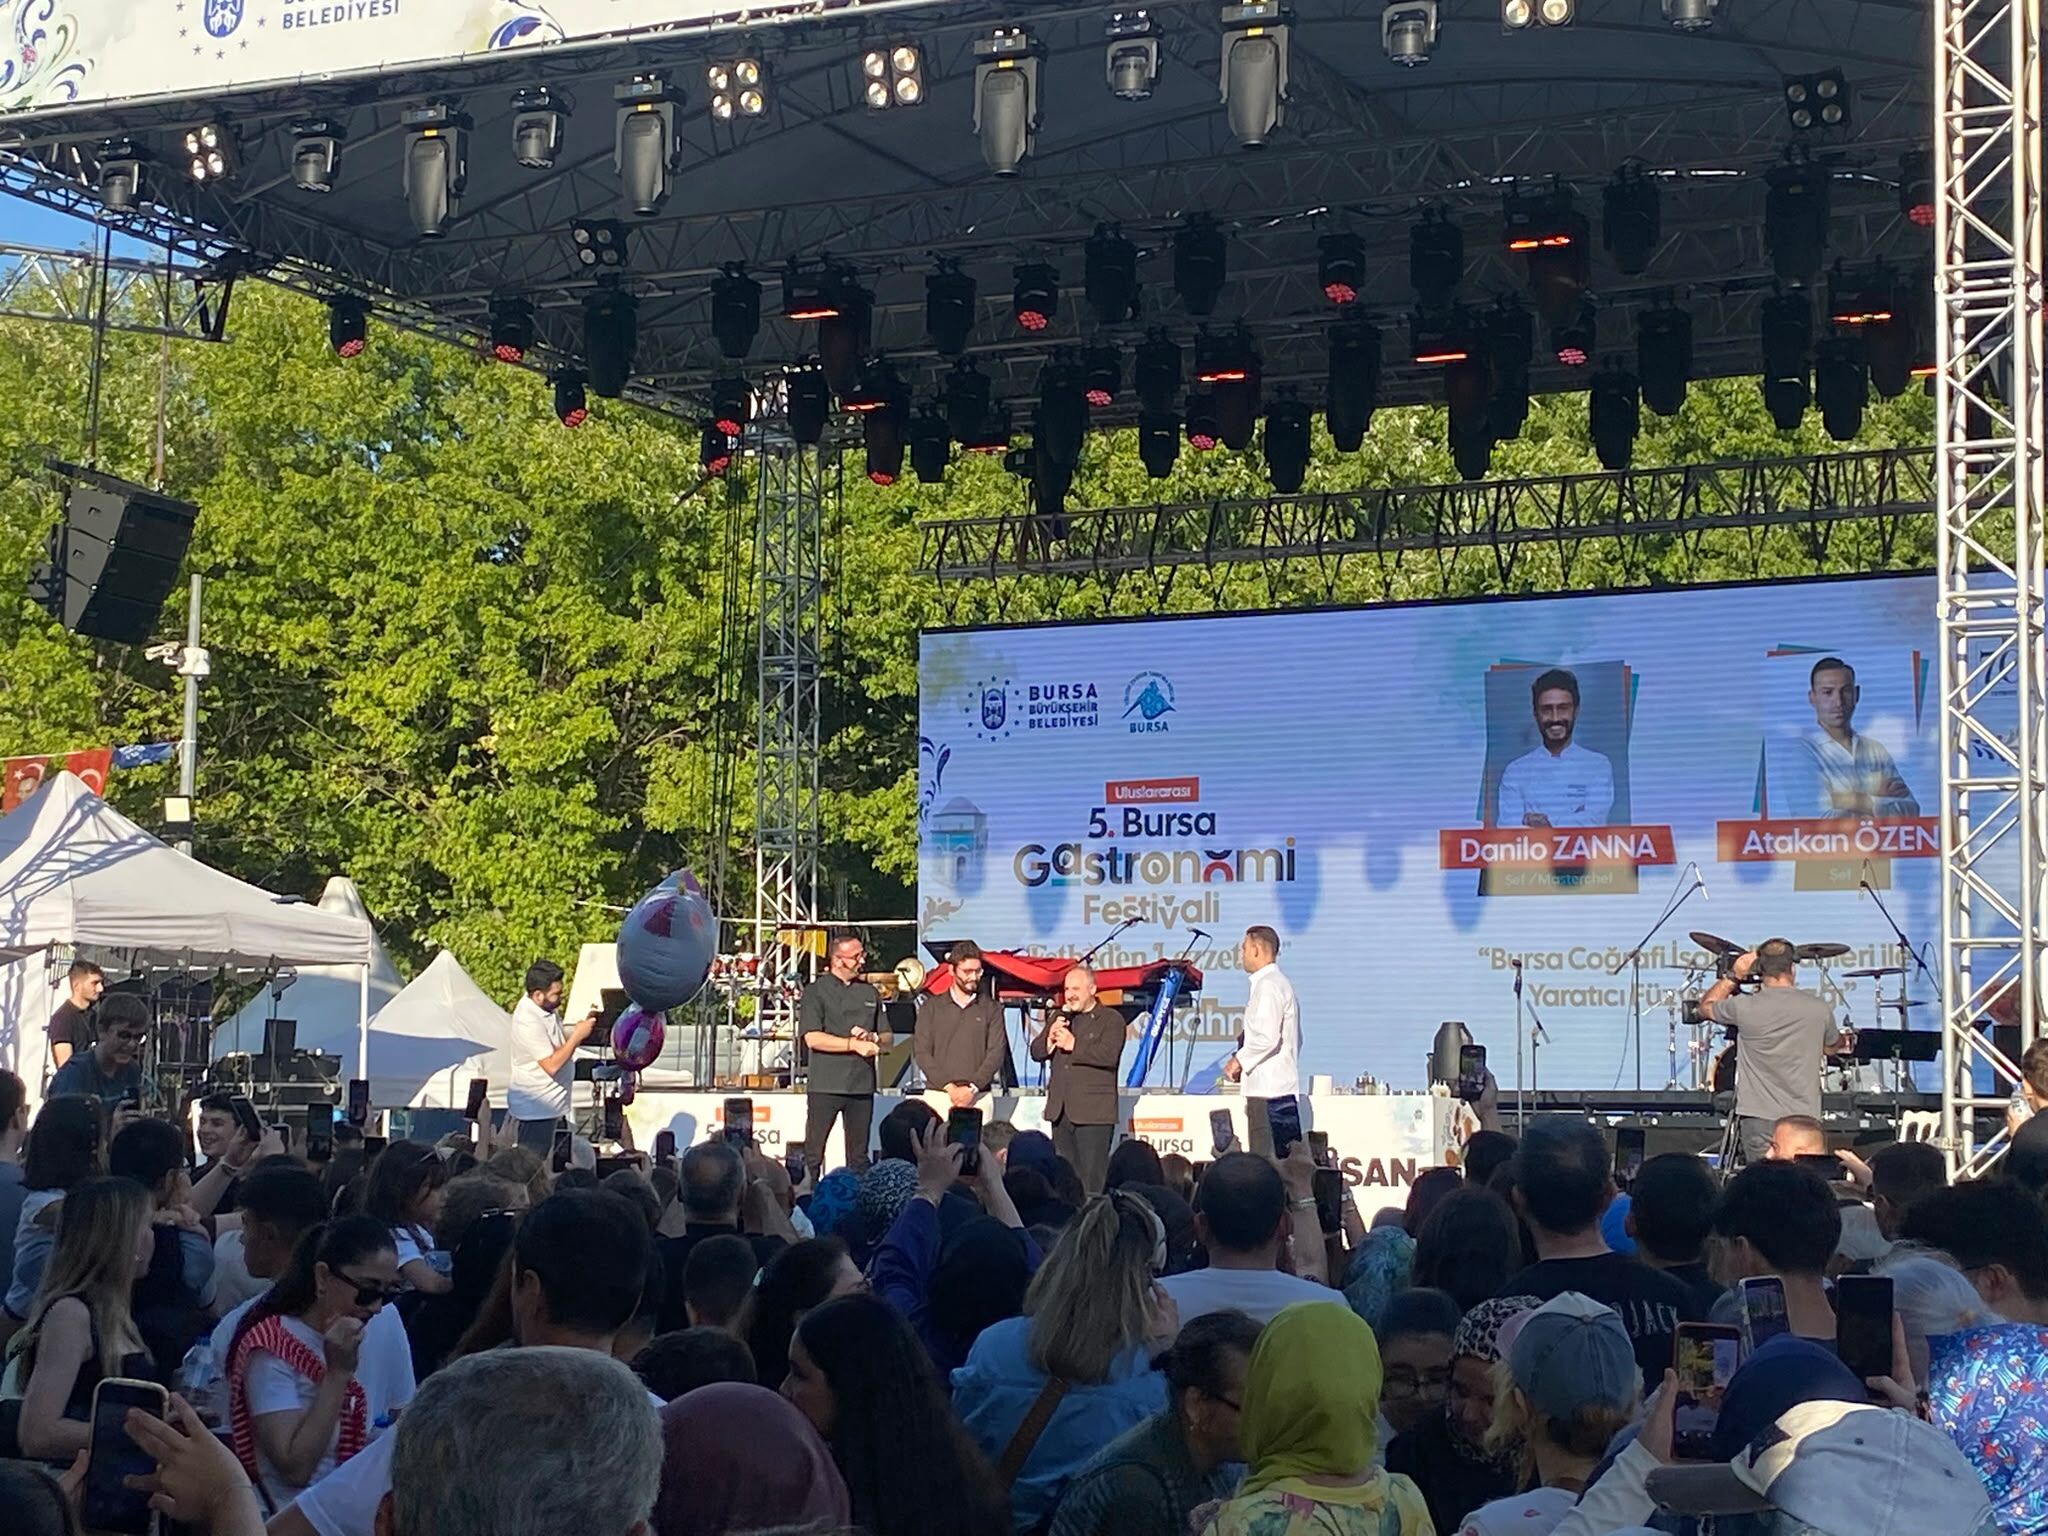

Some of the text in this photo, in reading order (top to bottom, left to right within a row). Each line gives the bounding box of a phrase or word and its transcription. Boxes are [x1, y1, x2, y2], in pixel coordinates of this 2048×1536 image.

[1029, 683, 1098, 701] BURSA
[1028, 700, 1098, 715] BÜYÜKŞEHİR
[1028, 713, 1098, 729] BELEDİYESİ
[1129, 721, 1169, 734] BURSA
[1114, 785, 1191, 800] Uluslararası
[1087, 807, 1216, 839] 5. Bursa
[1460, 833, 1658, 863] Danilo ZANNA
[1742, 820, 1940, 855] Atakan ÖZEN
[1013, 836, 1296, 887] Gastronomi
[1083, 891, 1220, 930] Festivali
[1528, 983, 1625, 1007] Yaratıcı
